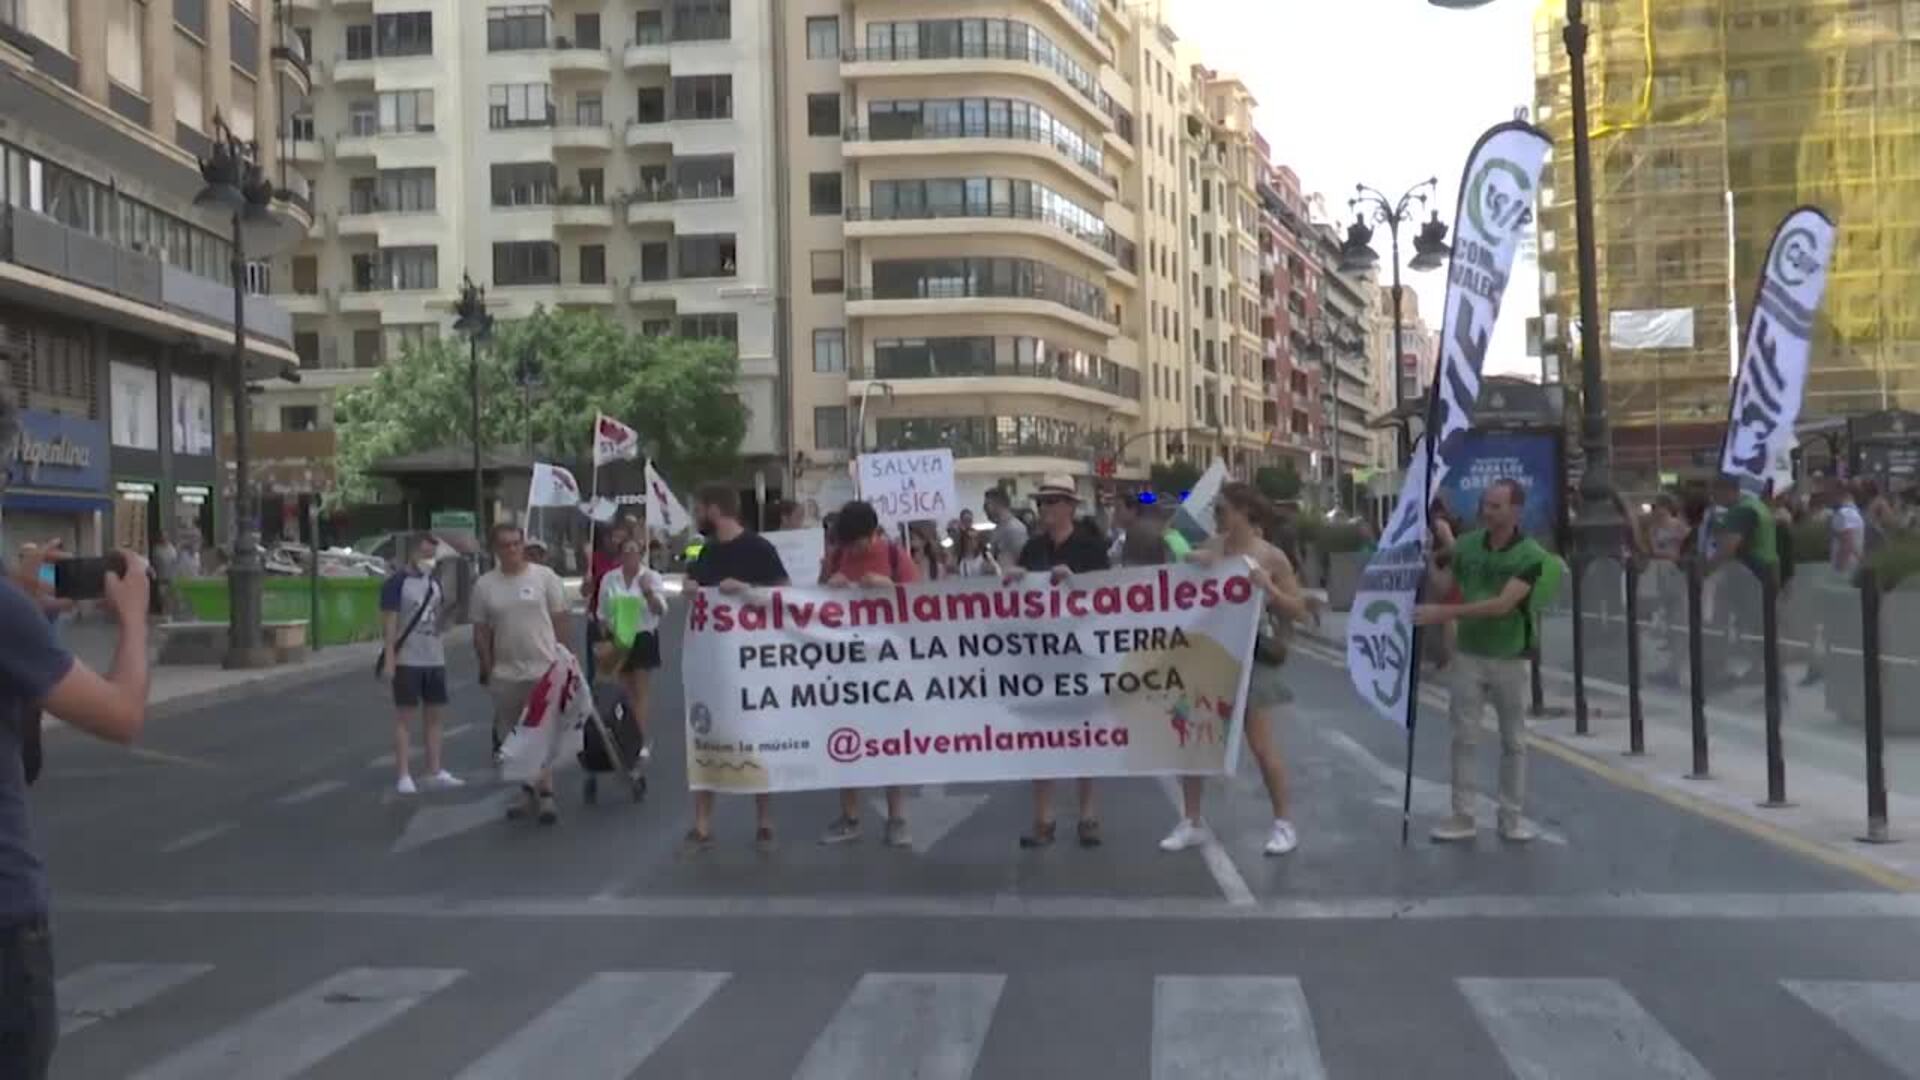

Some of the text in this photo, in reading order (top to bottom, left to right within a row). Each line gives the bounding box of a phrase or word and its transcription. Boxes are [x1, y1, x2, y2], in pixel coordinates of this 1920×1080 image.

[878, 639, 899, 662] A
[910, 635, 948, 660] LA
[959, 631, 1083, 658] NOSTRA
[1094, 626, 1190, 654] TERRA
[741, 686, 780, 711] LA
[790, 675, 914, 708] MÚSICA
[1000, 673, 1044, 697] NO
[1055, 672, 1089, 697] ES
[1100, 666, 1184, 695] TOCA
[827, 721, 1130, 763] @salvemlamusica
